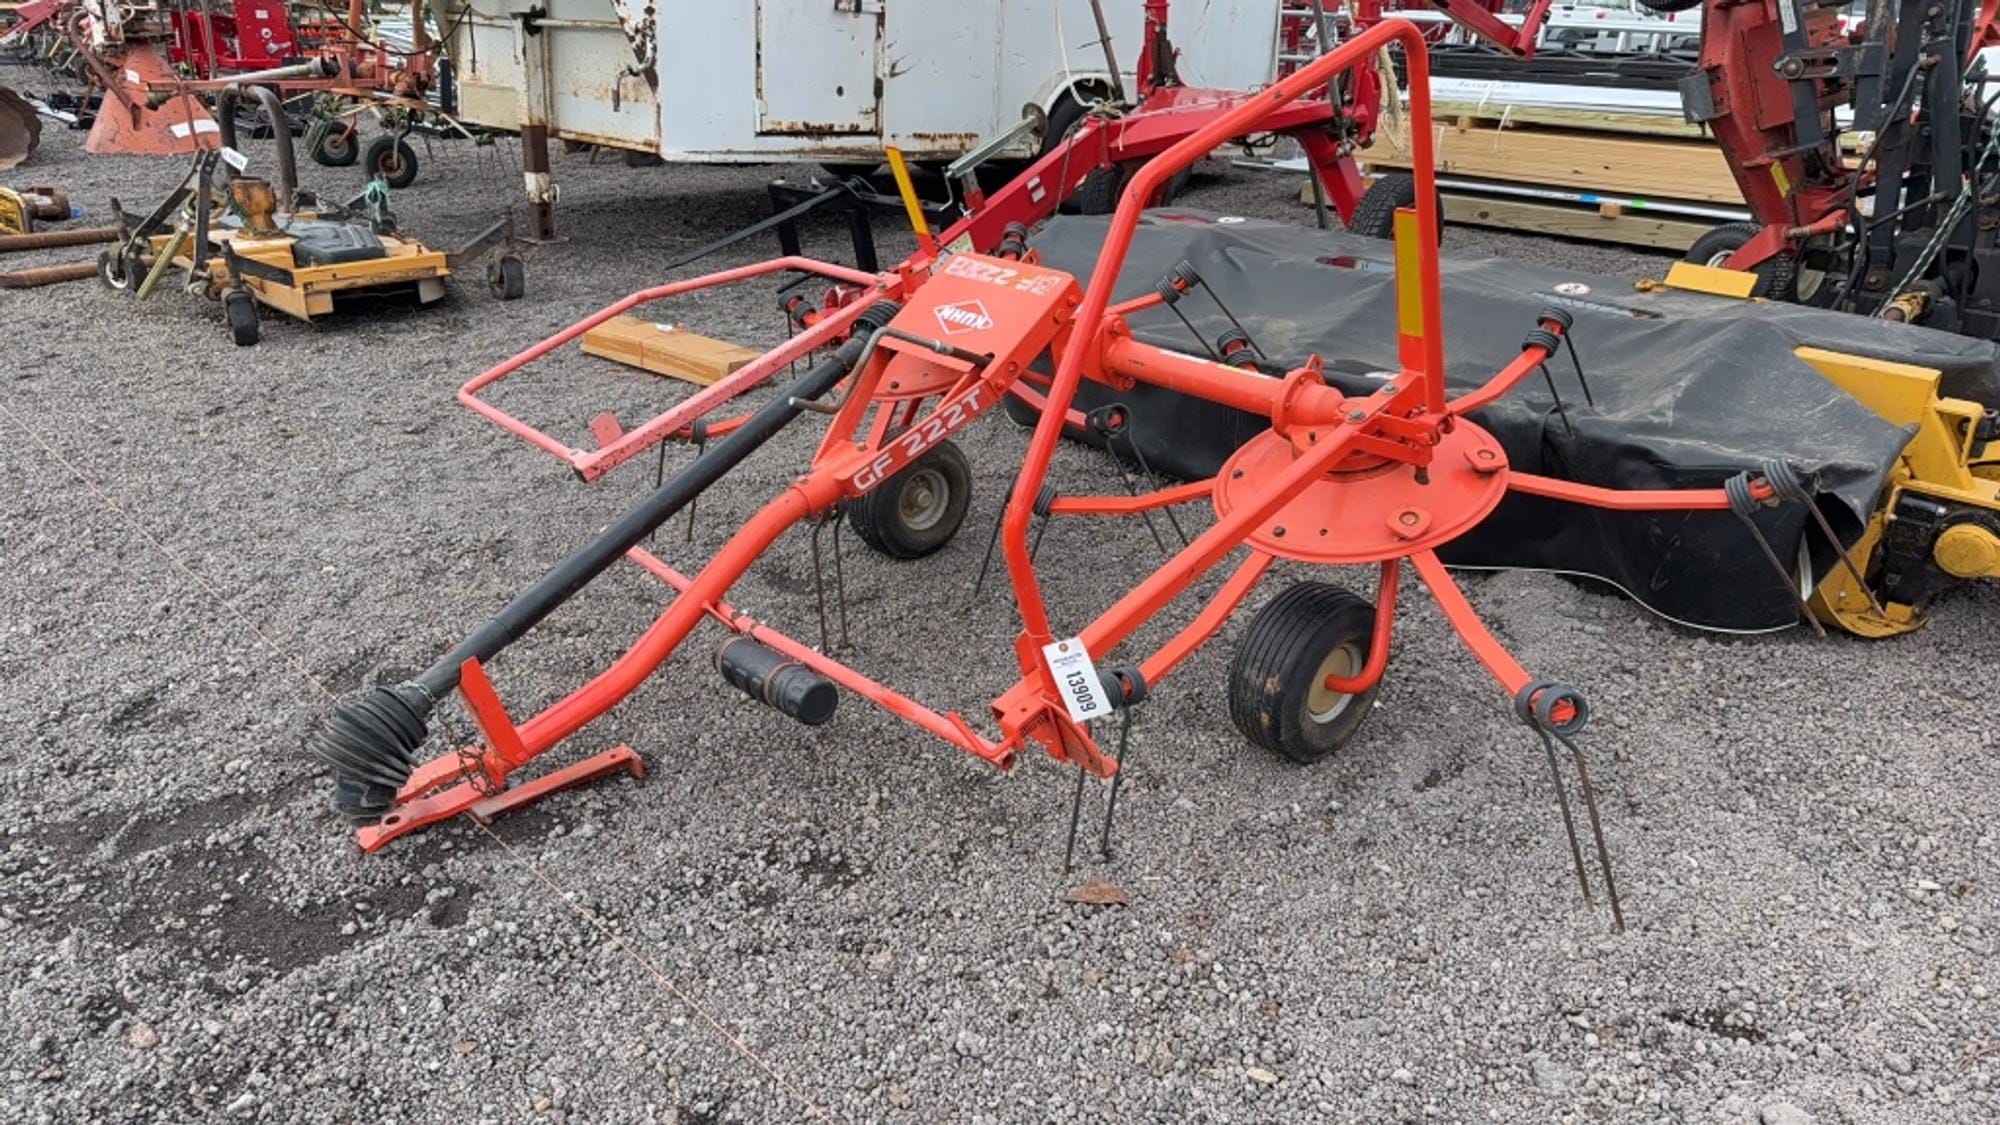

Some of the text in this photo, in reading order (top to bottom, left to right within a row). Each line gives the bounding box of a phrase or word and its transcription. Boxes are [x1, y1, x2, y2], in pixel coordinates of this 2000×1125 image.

[939, 305, 989, 329] KUHN
[853, 387, 980, 490] GF 222T
[1066, 669, 1097, 712] 13909
